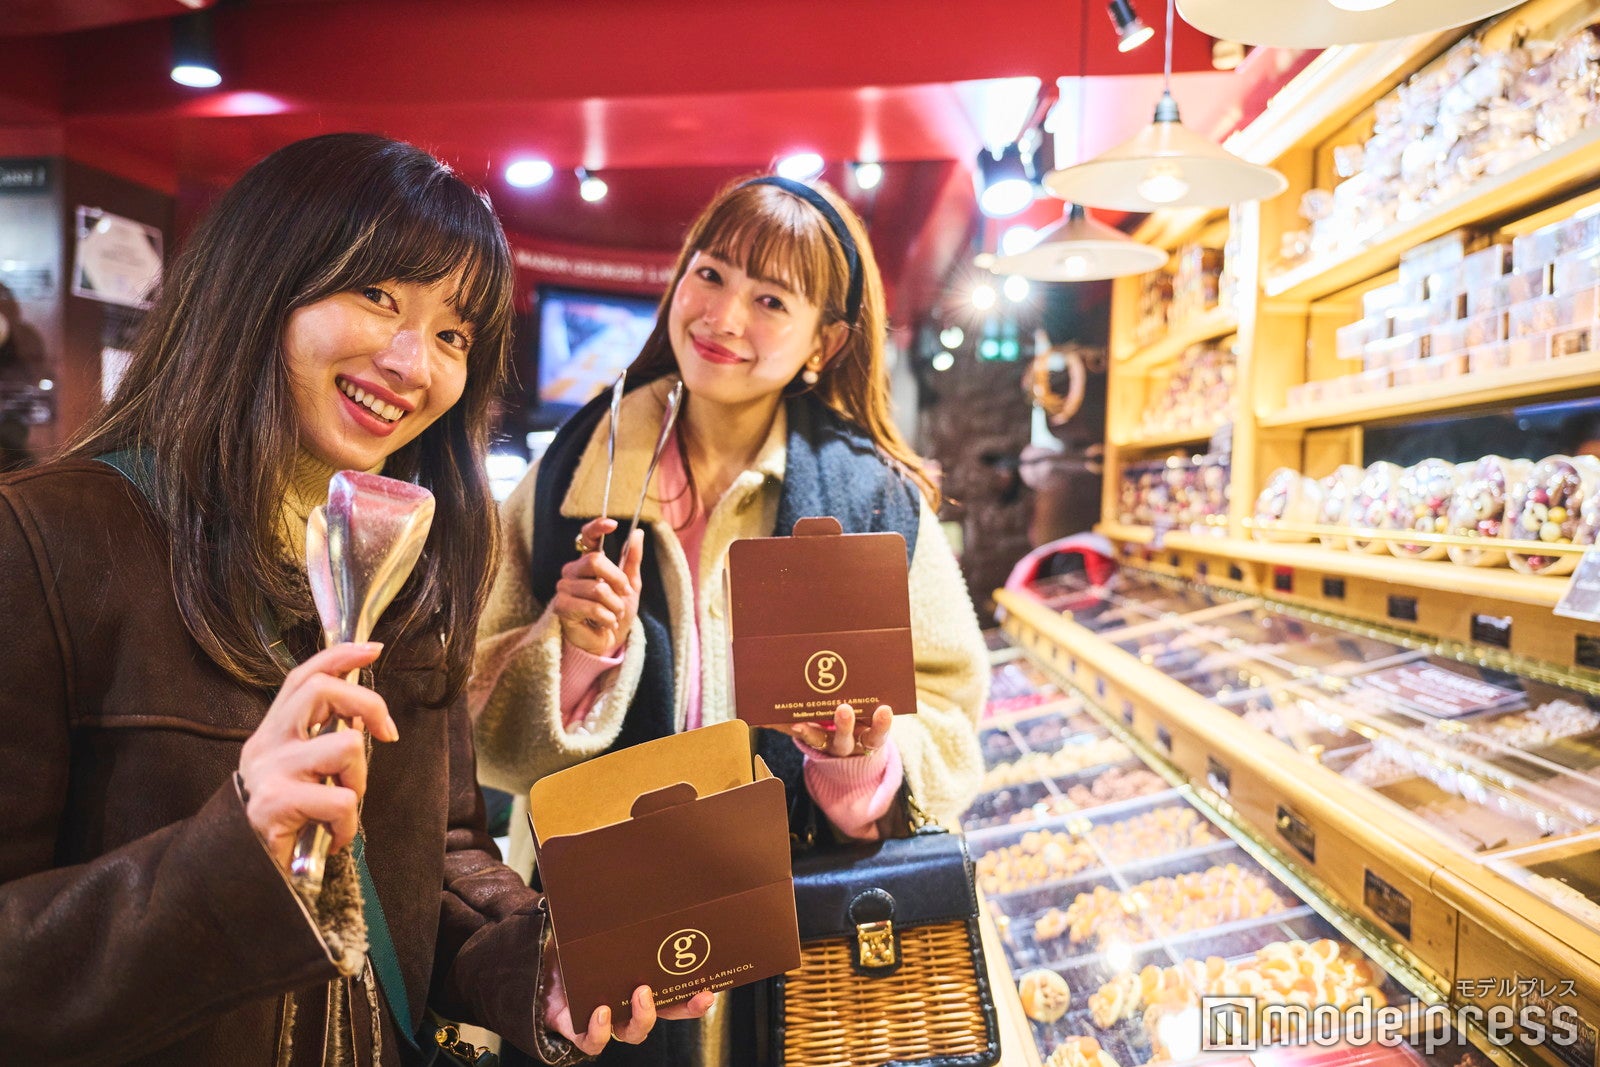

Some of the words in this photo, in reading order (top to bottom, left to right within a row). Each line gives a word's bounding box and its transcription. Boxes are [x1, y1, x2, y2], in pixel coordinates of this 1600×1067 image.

[774, 702, 804, 710] MAISON
[806, 699, 842, 708] GEORGES
[843, 697, 880, 705] LARNICOL
[662, 978, 706, 995] GEORGES
[709, 963, 755, 981] LARNICOL
[711, 980, 734, 990] France
